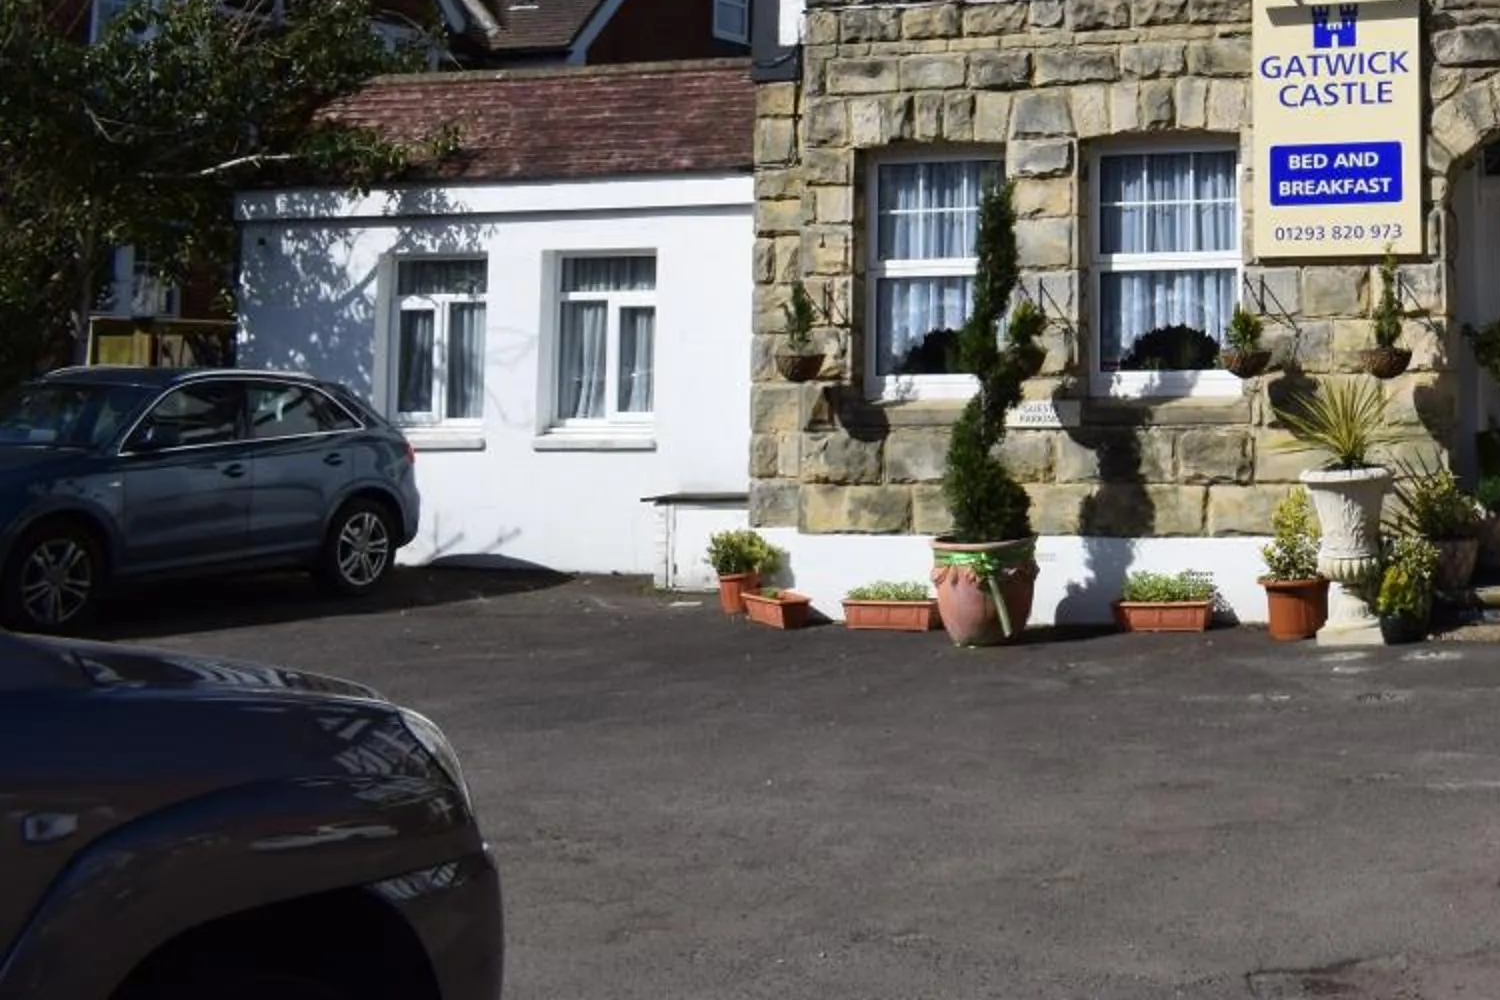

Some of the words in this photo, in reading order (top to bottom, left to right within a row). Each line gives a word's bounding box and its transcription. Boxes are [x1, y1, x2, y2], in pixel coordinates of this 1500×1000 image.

[1260, 51, 1409, 79] GATWICK
[1278, 81, 1393, 107] CASTLE
[1288, 153, 1328, 169] BED
[1334, 152, 1379, 168] AND
[1279, 177, 1392, 196] BREAKFAST
[1274, 226, 1325, 241] 01293
[1331, 225, 1365, 240] 820
[1370, 224, 1402, 239] 973
